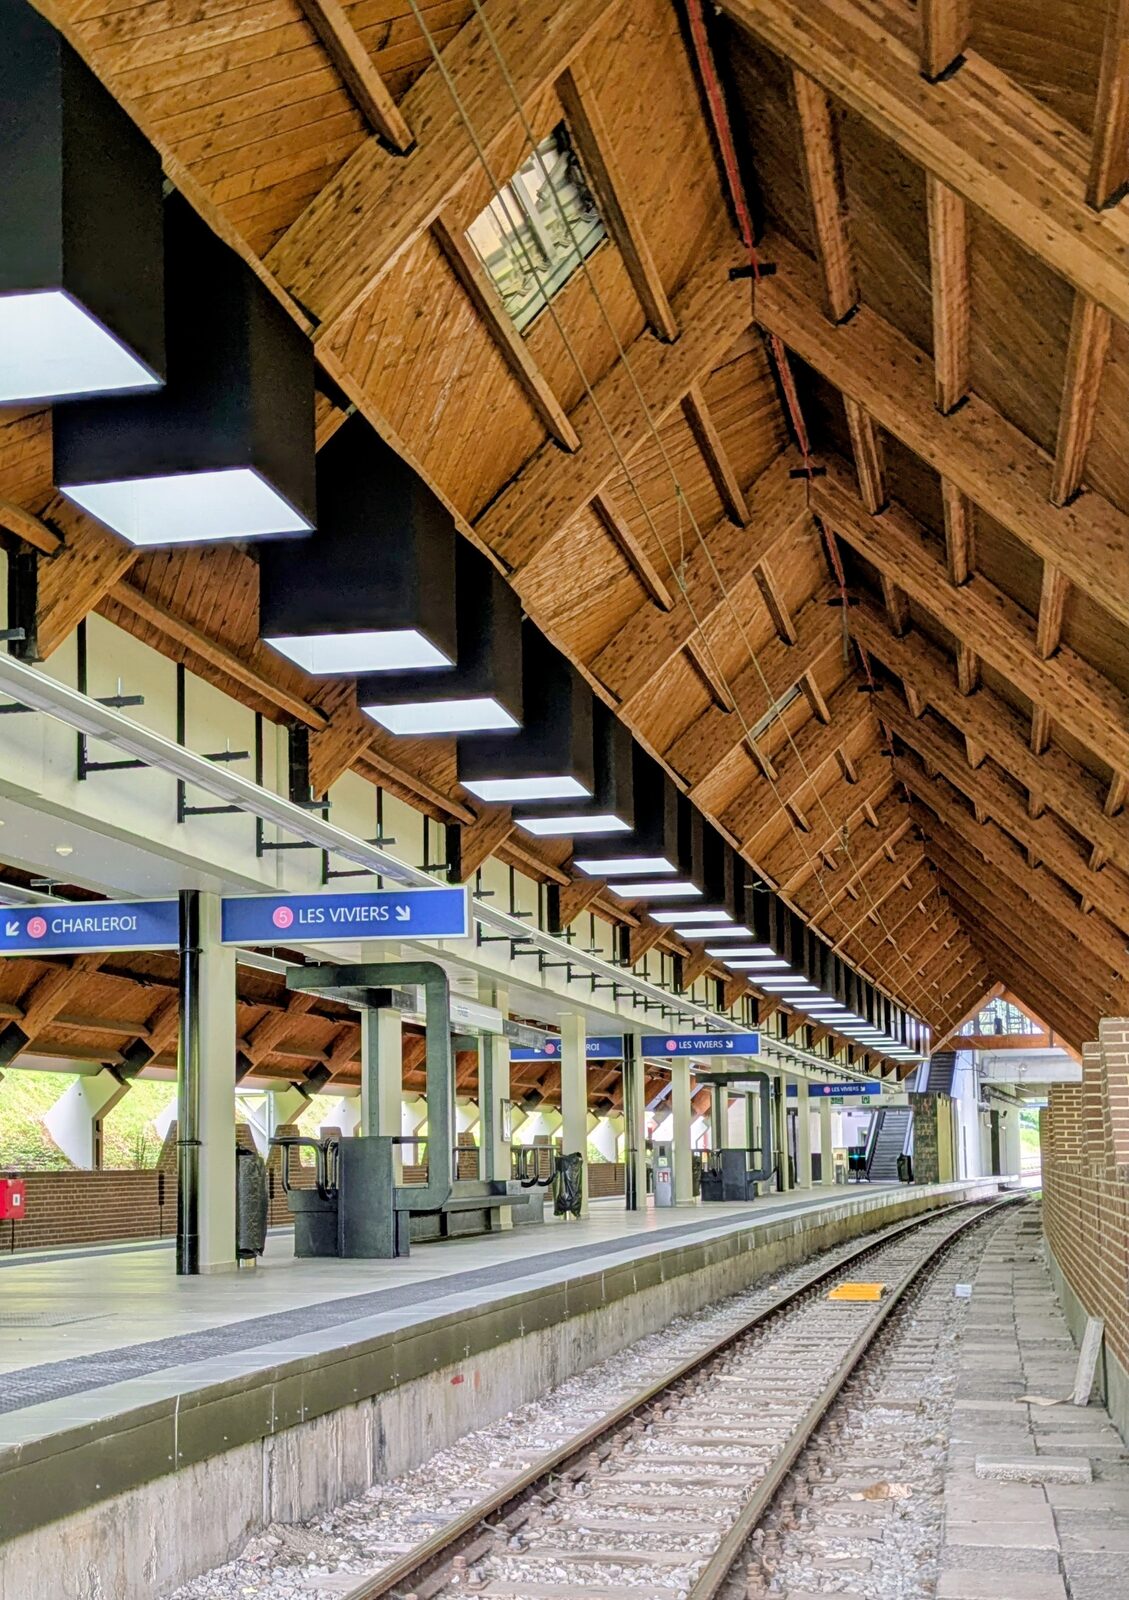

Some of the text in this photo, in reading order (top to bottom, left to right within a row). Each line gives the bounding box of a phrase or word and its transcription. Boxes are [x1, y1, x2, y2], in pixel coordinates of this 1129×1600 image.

[278, 906, 389, 924] 5 LES VIVIERS
[33, 916, 137, 933] 5 CHARLEROI
[679, 1041, 692, 1049] LES
[694, 1040, 723, 1049] VIVIERS
